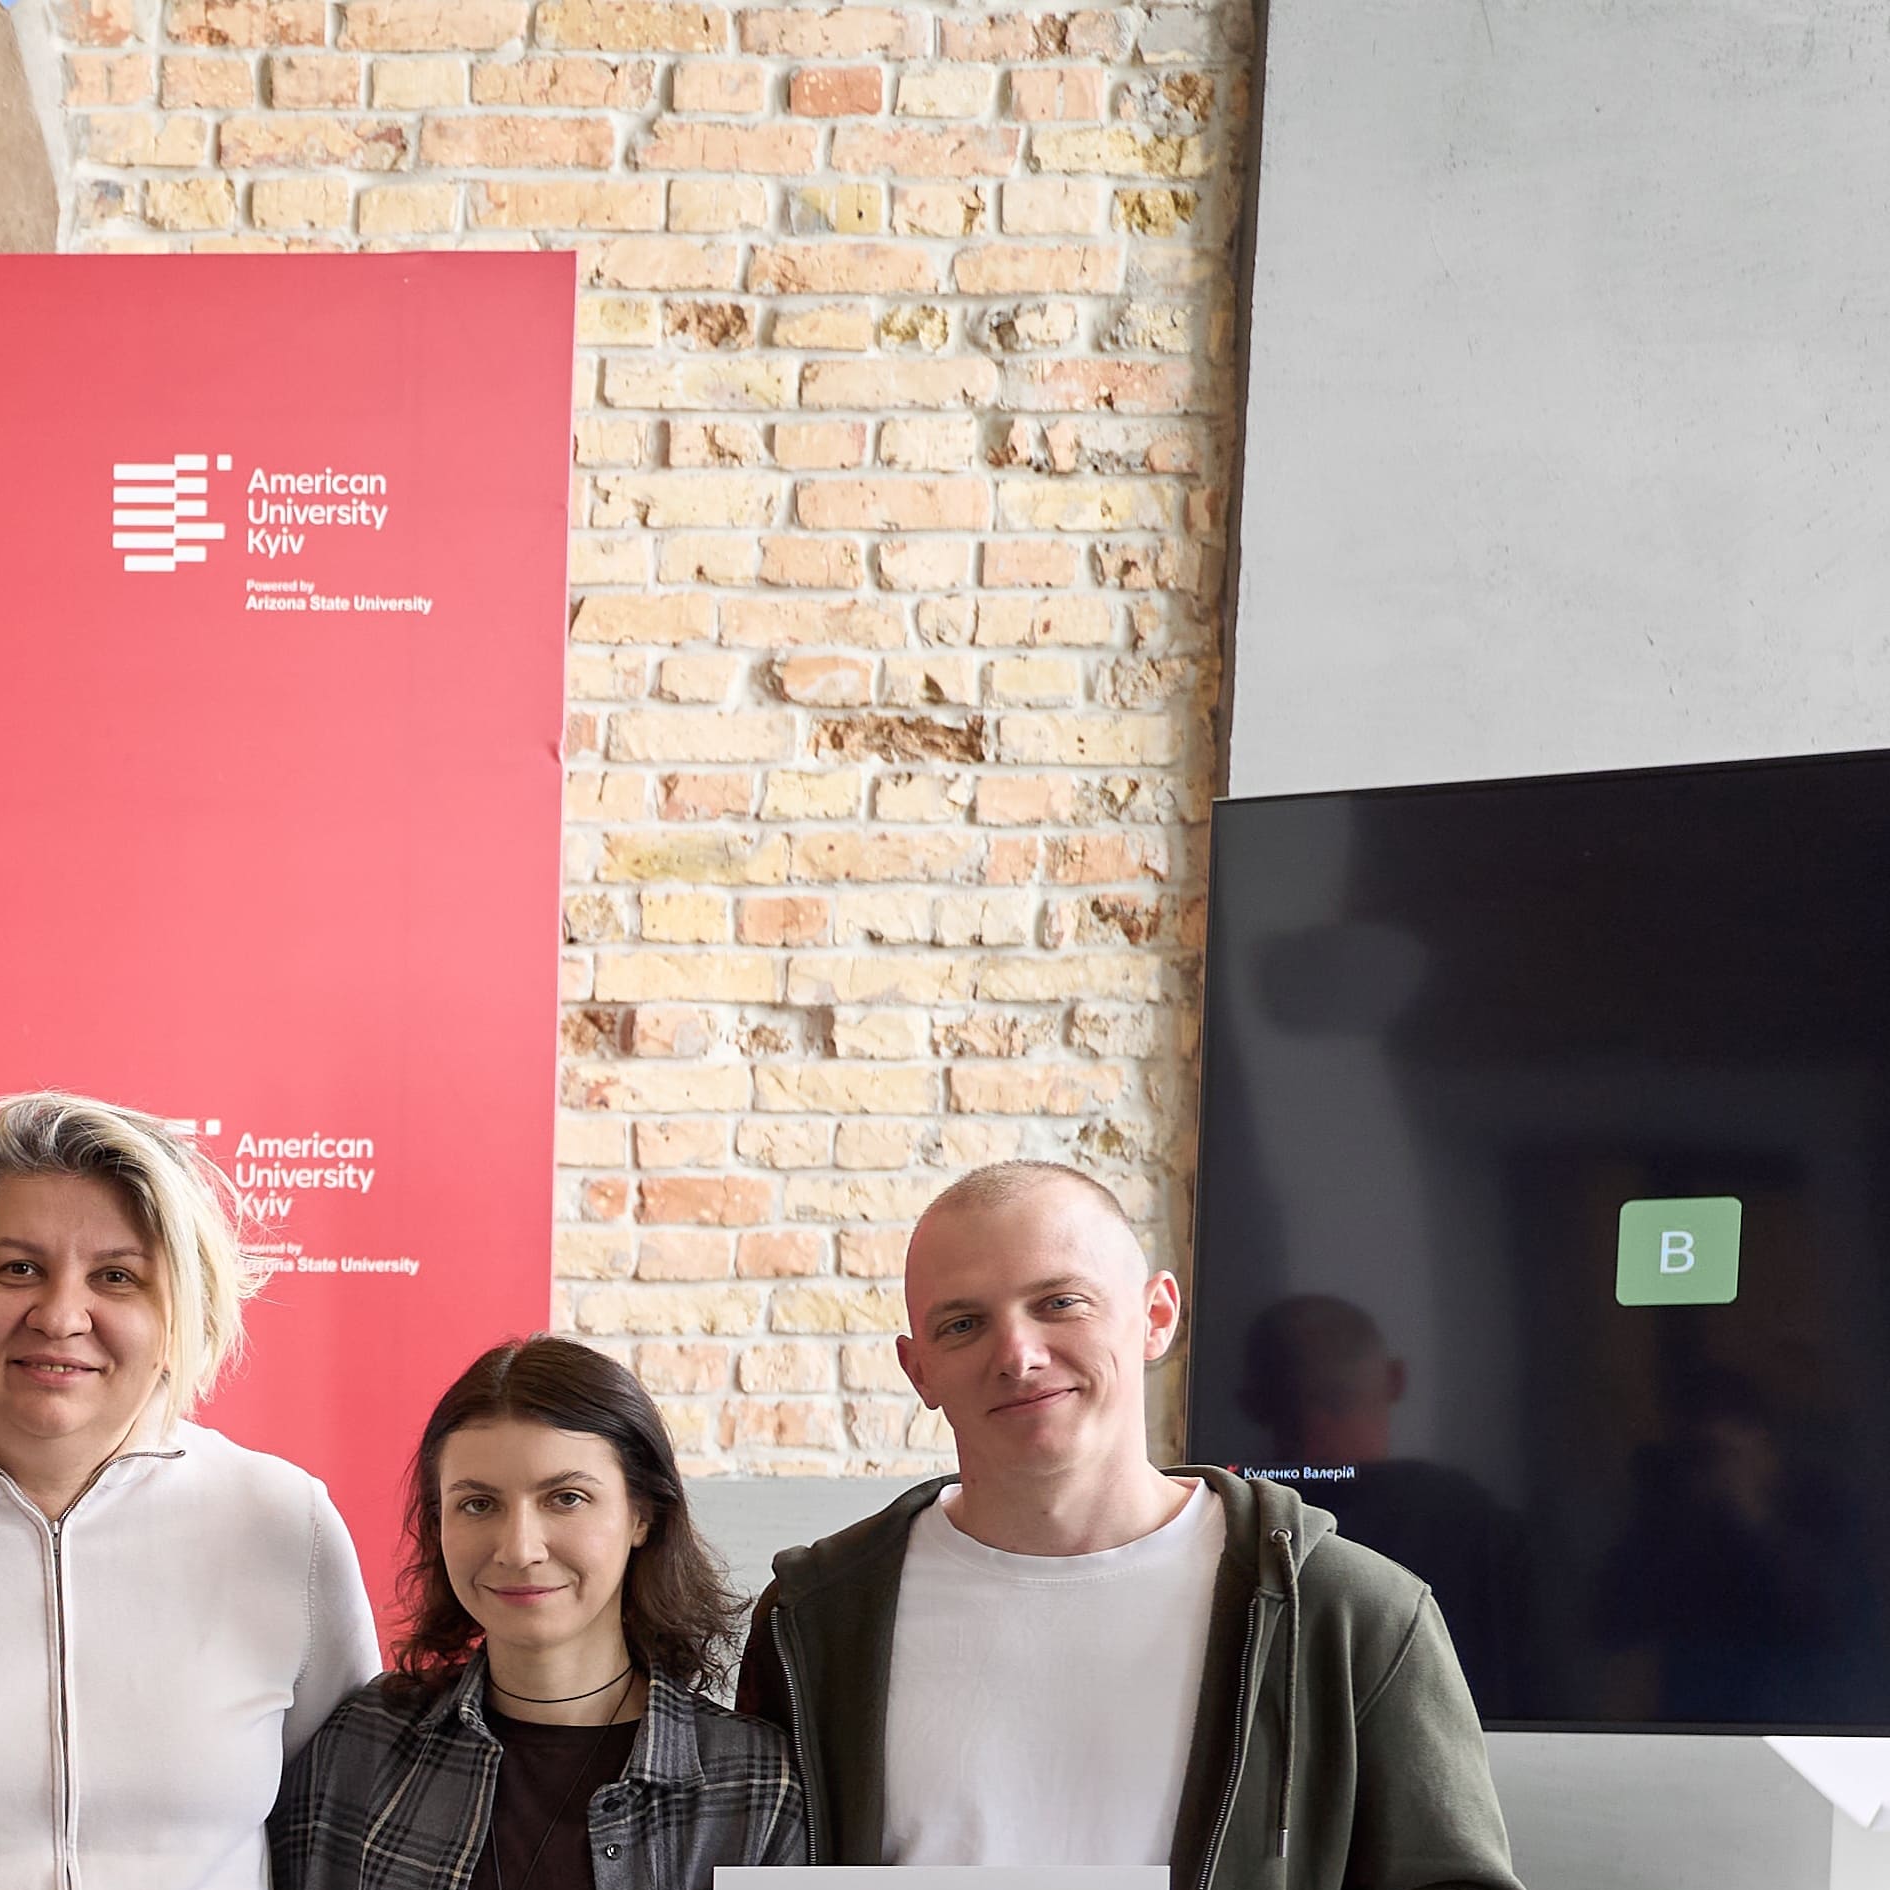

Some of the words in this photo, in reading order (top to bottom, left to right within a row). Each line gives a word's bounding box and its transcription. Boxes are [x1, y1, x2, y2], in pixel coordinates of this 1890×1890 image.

[248, 468, 386, 494] American
[249, 498, 388, 529] University
[249, 527, 306, 558] Kyiv
[247, 580, 297, 593] Powered
[300, 580, 314, 594] by
[246, 595, 306, 612] Arizona
[310, 595, 350, 612] State
[354, 595, 432, 614] University
[235, 1131, 374, 1158] American
[236, 1162, 374, 1193] University
[236, 1191, 292, 1221] Kyiv
[288, 1243, 302, 1256] by
[298, 1257, 337, 1273] State
[341, 1257, 419, 1276] University
[1303, 1465, 1355, 1482] Валерій
